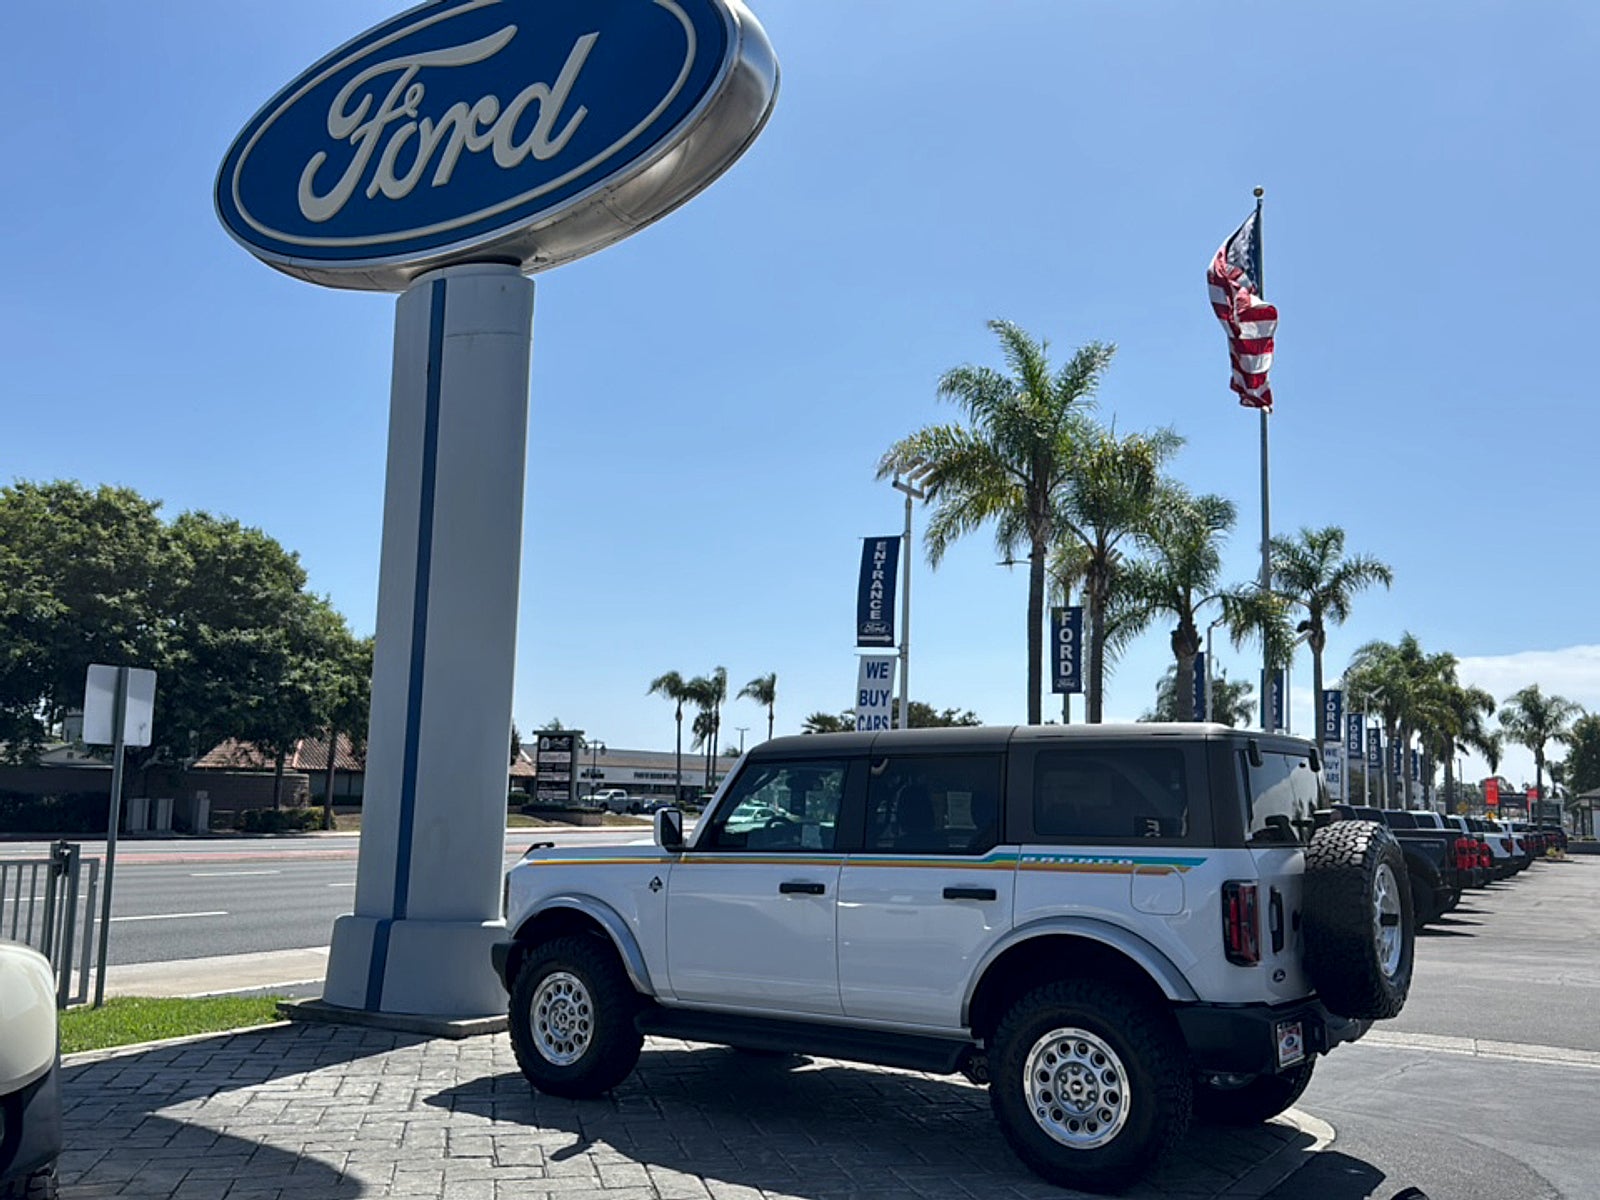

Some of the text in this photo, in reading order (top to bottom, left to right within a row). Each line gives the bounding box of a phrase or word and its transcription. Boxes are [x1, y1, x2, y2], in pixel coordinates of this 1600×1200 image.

[298, 24, 600, 223] Ford
[869, 541, 887, 620] ENTRANCE
[1059, 611, 1073, 677] FORD
[867, 661, 889, 679] WE
[858, 689, 890, 707] BUY
[1326, 691, 1336, 731] FORD
[857, 714, 889, 731] CARS
[1349, 714, 1358, 750] FORD
[1369, 729, 1377, 760] FORD
